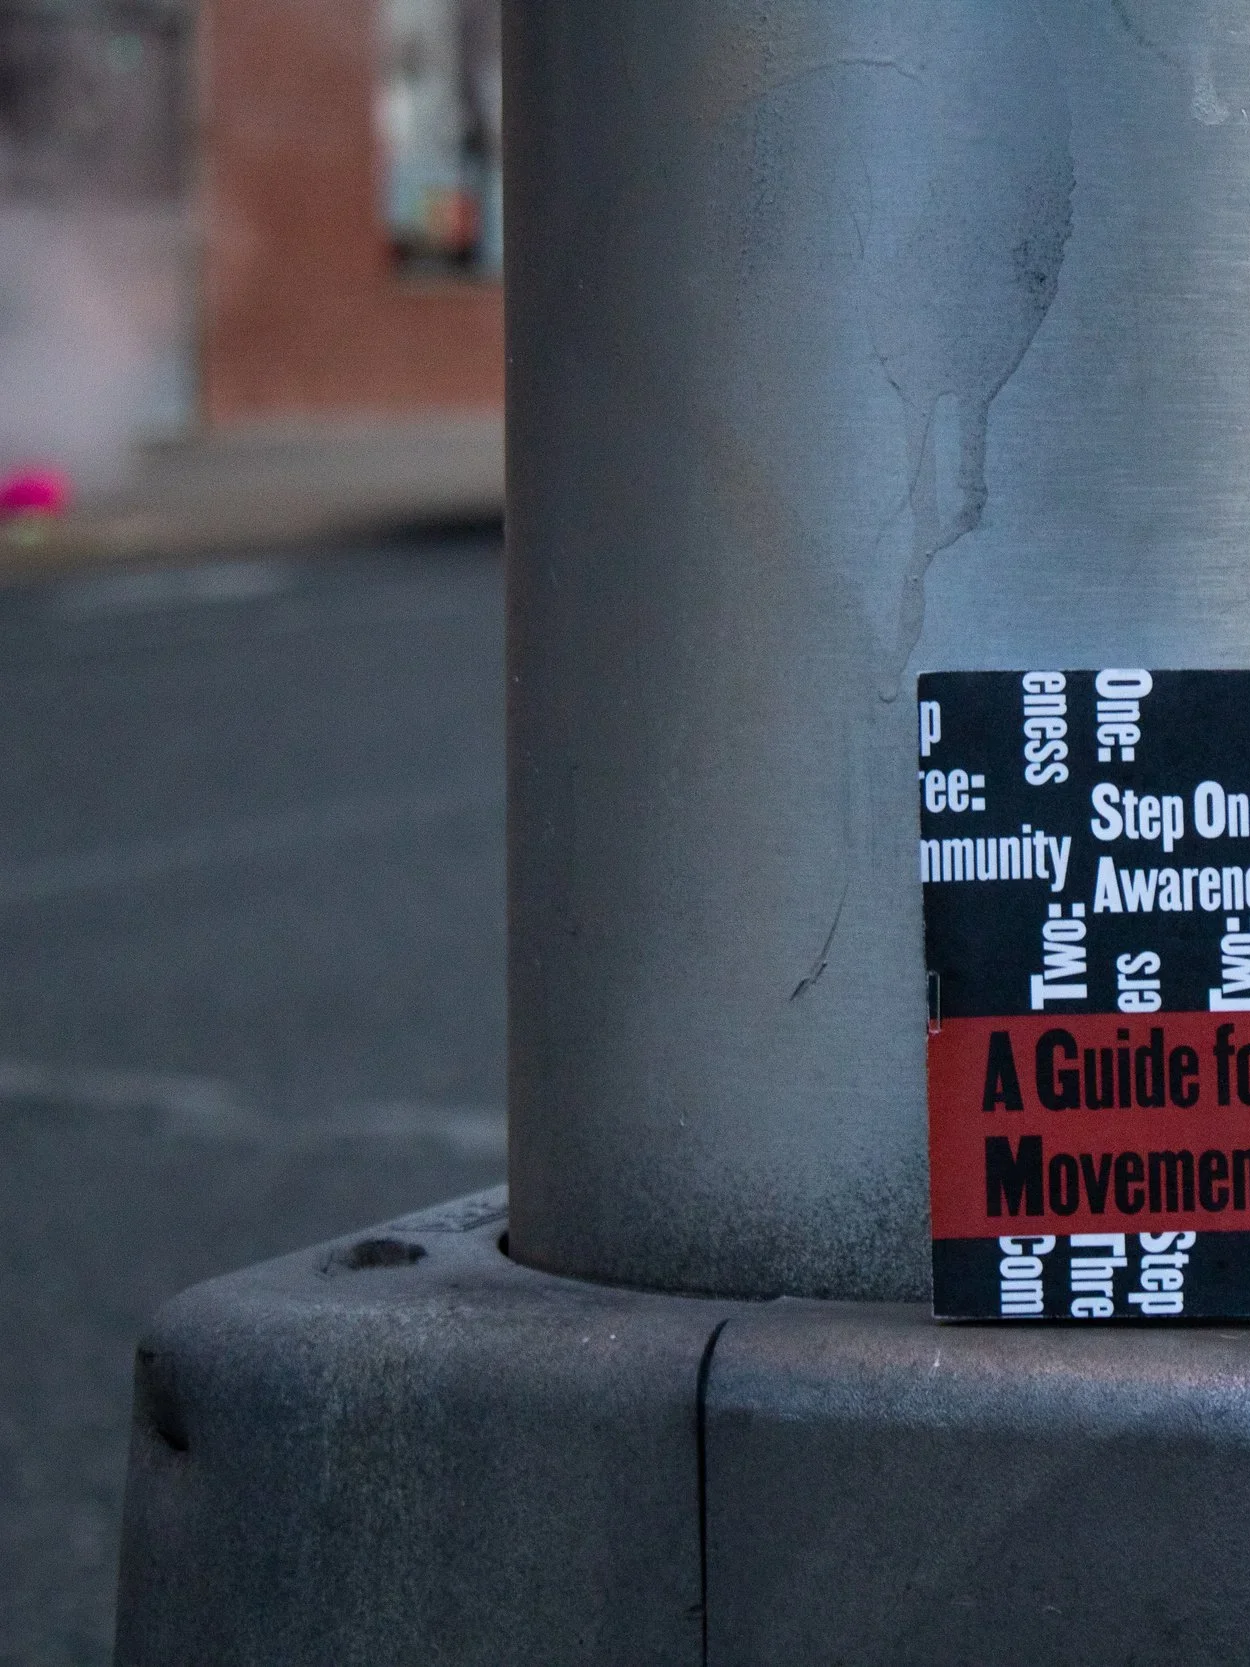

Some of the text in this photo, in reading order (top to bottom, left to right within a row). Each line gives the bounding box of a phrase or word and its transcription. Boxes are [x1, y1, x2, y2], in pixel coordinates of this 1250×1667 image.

[1022, 671, 1069, 786] eness
[1095, 668, 1153, 762] One:
[1091, 783, 1184, 852] Step
[1030, 903, 1088, 1011] Two:
[1116, 950, 1162, 1013] ers
[982, 1030, 1021, 1112] A
[1035, 1027, 1199, 1112] Guide
[1070, 1233, 1128, 1319] Thre
[1128, 1230, 1197, 1315] Step
